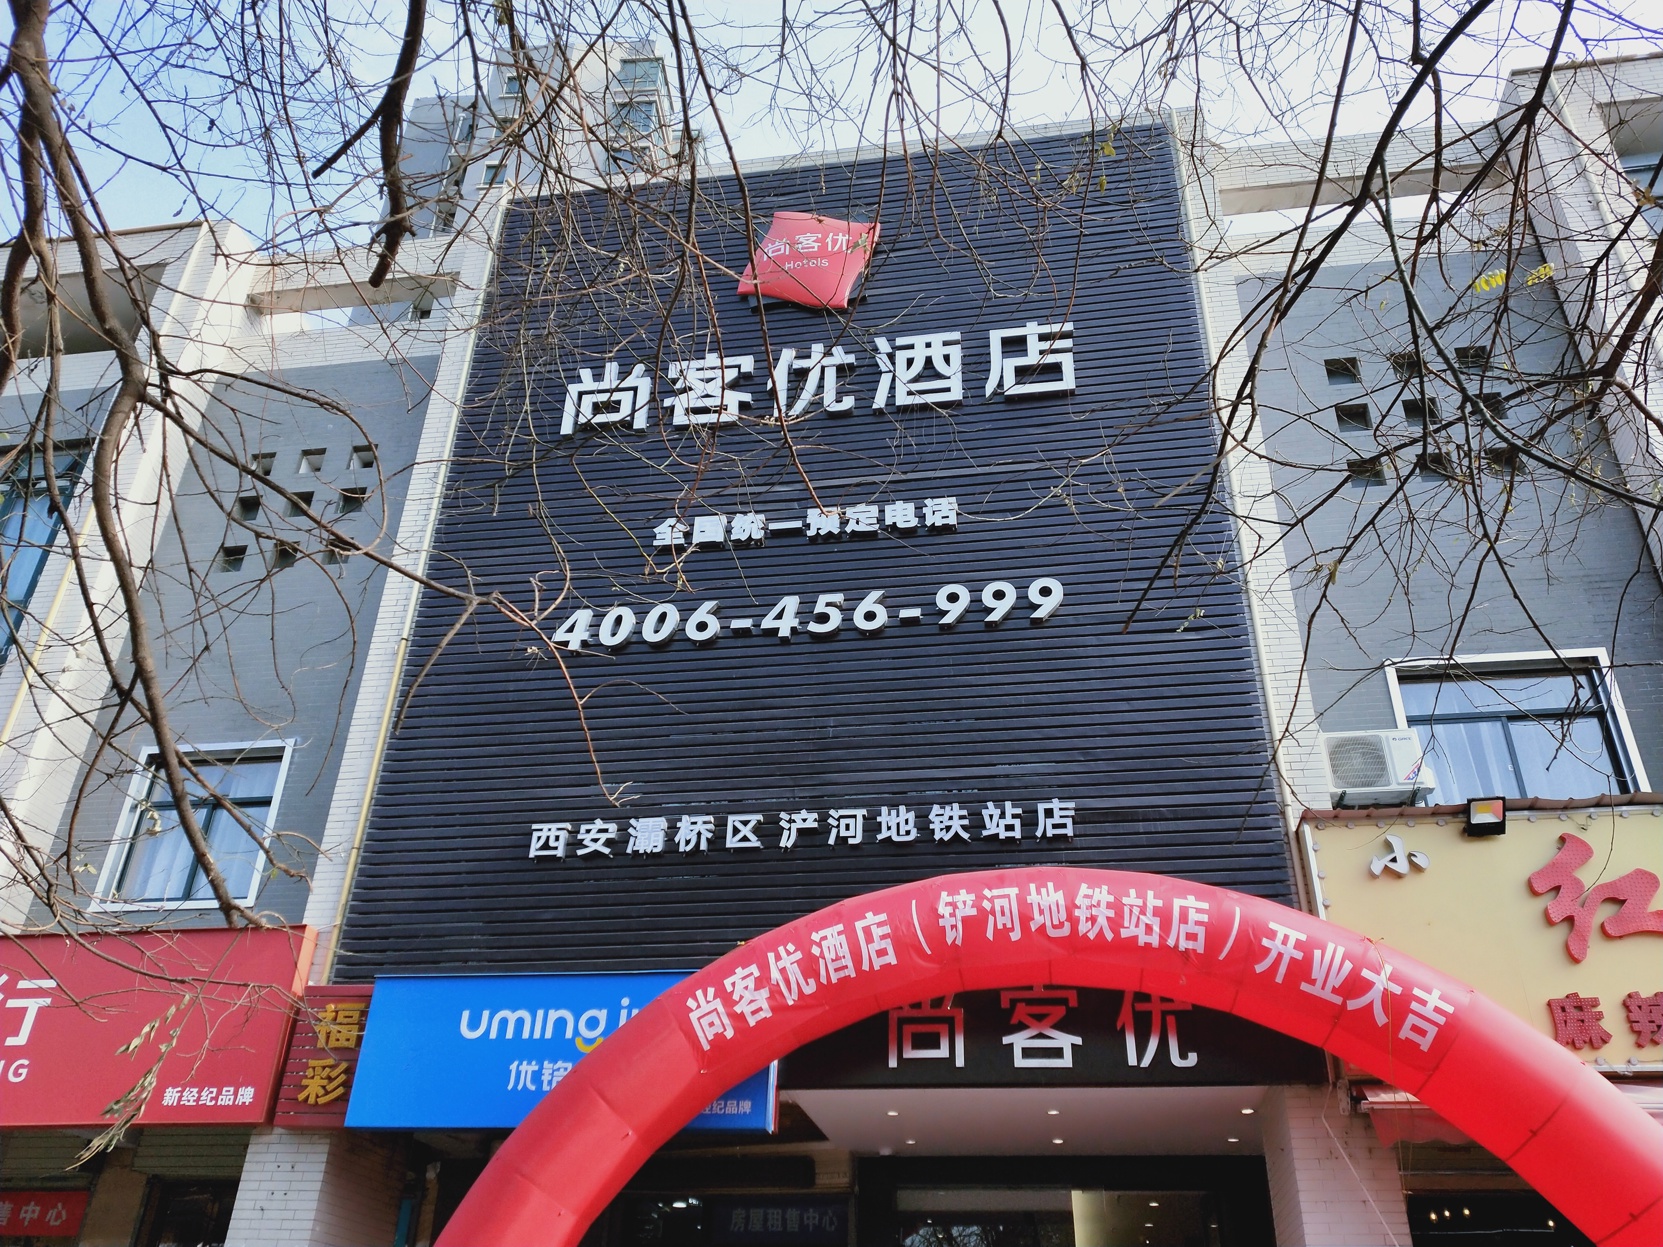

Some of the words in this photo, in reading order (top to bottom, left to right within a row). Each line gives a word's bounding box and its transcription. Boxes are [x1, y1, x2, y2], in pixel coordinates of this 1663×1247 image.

[763, 232, 853, 261] 尚客优
[785, 258, 829, 271] Hotels
[560, 321, 1077, 436] 尚客优酒店
[653, 496, 958, 547] 全国统一预定电话
[551, 577, 1065, 653] 4006-456-999
[528, 798, 1077, 859] 西安灞桥区浐河地铁站店
[1369, 834, 1431, 878] 小
[1528, 832, 1663, 964] 红
[298, 1003, 367, 1105] 福彩
[888, 984, 1198, 1069] 尚客优
[162, 1086, 255, 1107] 新经纪品牌
[730, 1208, 838, 1233] 房屋租售中心
